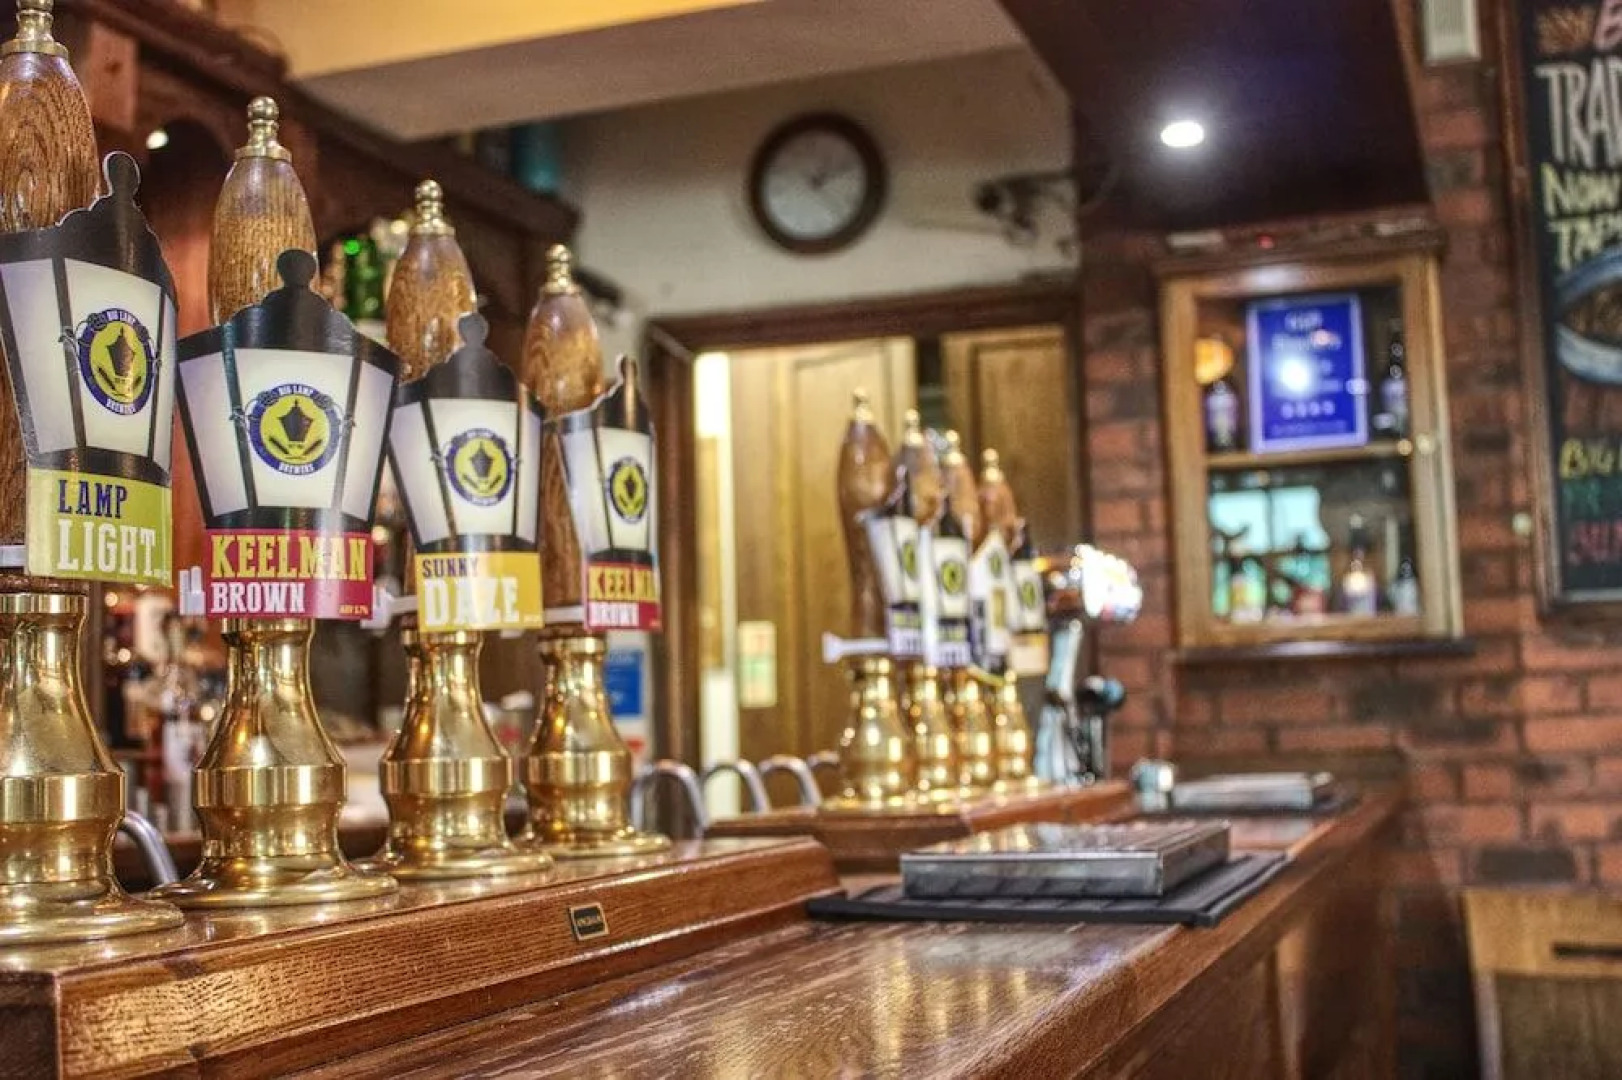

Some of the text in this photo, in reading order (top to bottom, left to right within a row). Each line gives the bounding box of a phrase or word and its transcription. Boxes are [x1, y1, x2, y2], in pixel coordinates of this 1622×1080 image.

[57, 479, 128, 519] LAMP
[56, 518, 157, 577] LIGHT
[210, 533, 367, 581] KEELMAN
[421, 557, 479, 578] SUNNY
[210, 581, 306, 614] BROWN
[423, 576, 520, 627] DAZE
